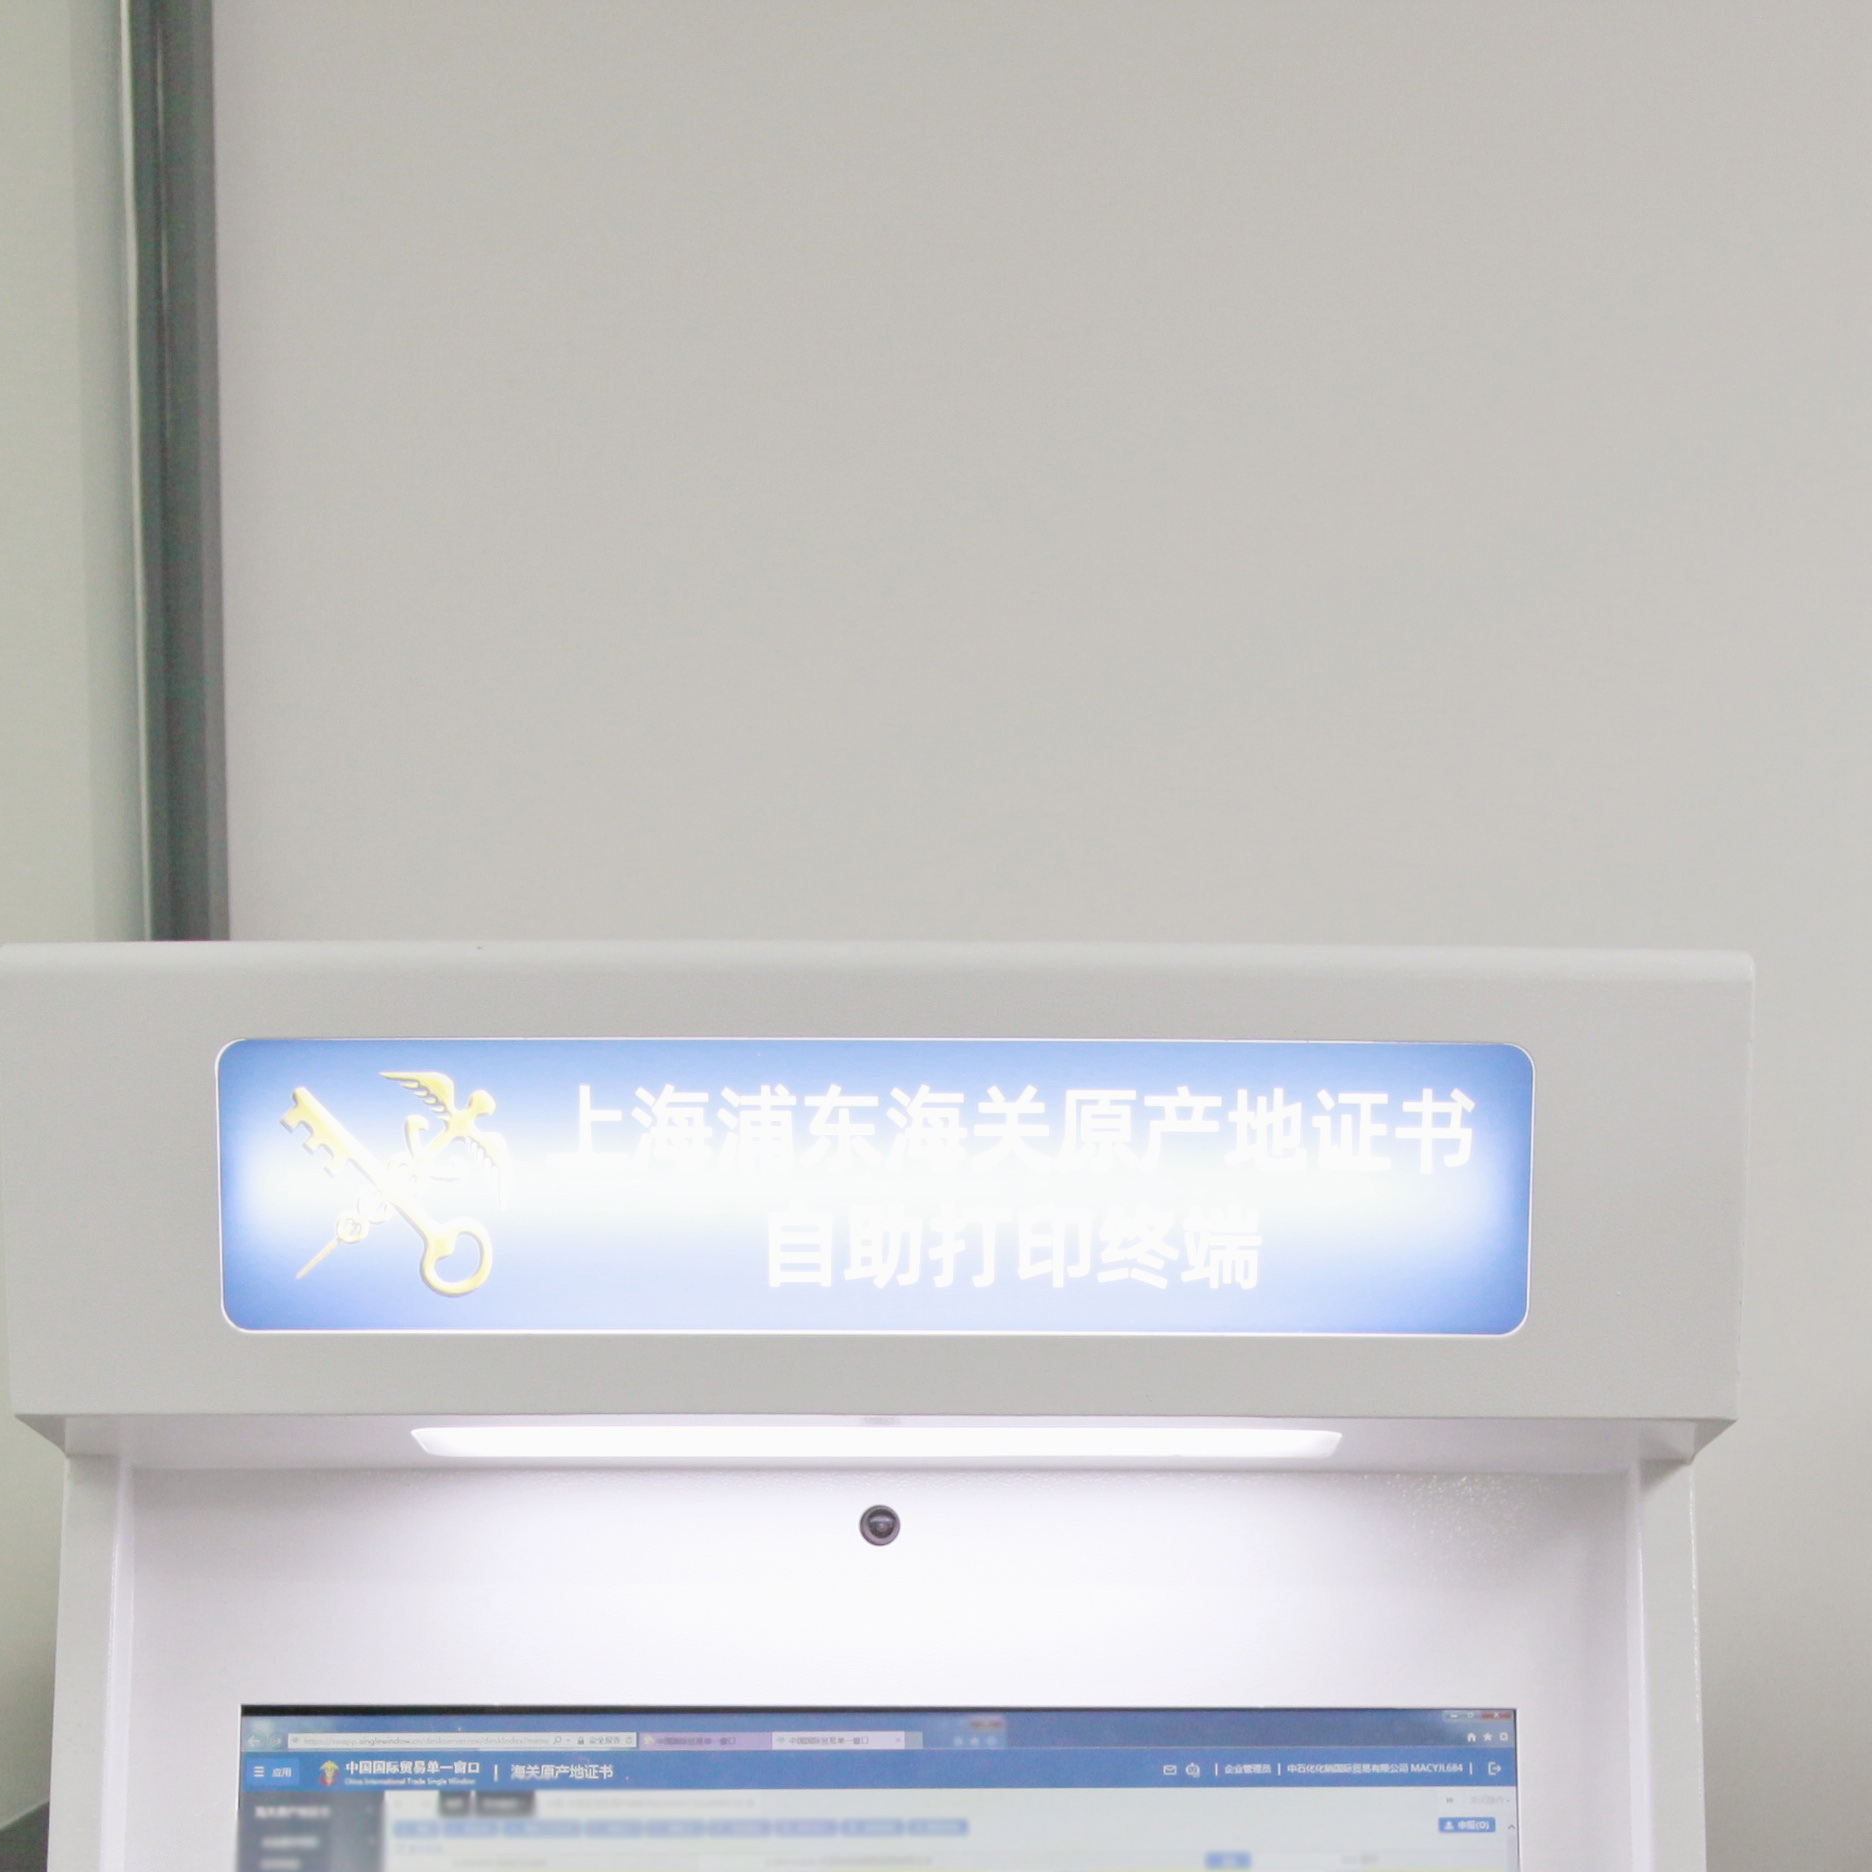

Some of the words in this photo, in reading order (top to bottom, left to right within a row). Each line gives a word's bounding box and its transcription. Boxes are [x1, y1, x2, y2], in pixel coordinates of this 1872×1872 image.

[558, 1083, 1478, 1177] 上海浦东海关原产地证书
[765, 1206, 1262, 1291] 自助打印终端
[345, 1760, 481, 1775] 中国国际贸易单一窗口
[511, 1764, 614, 1780] 海关原产地证书
[407, 1777, 426, 1786] Trade
[427, 1777, 447, 1787] Single
